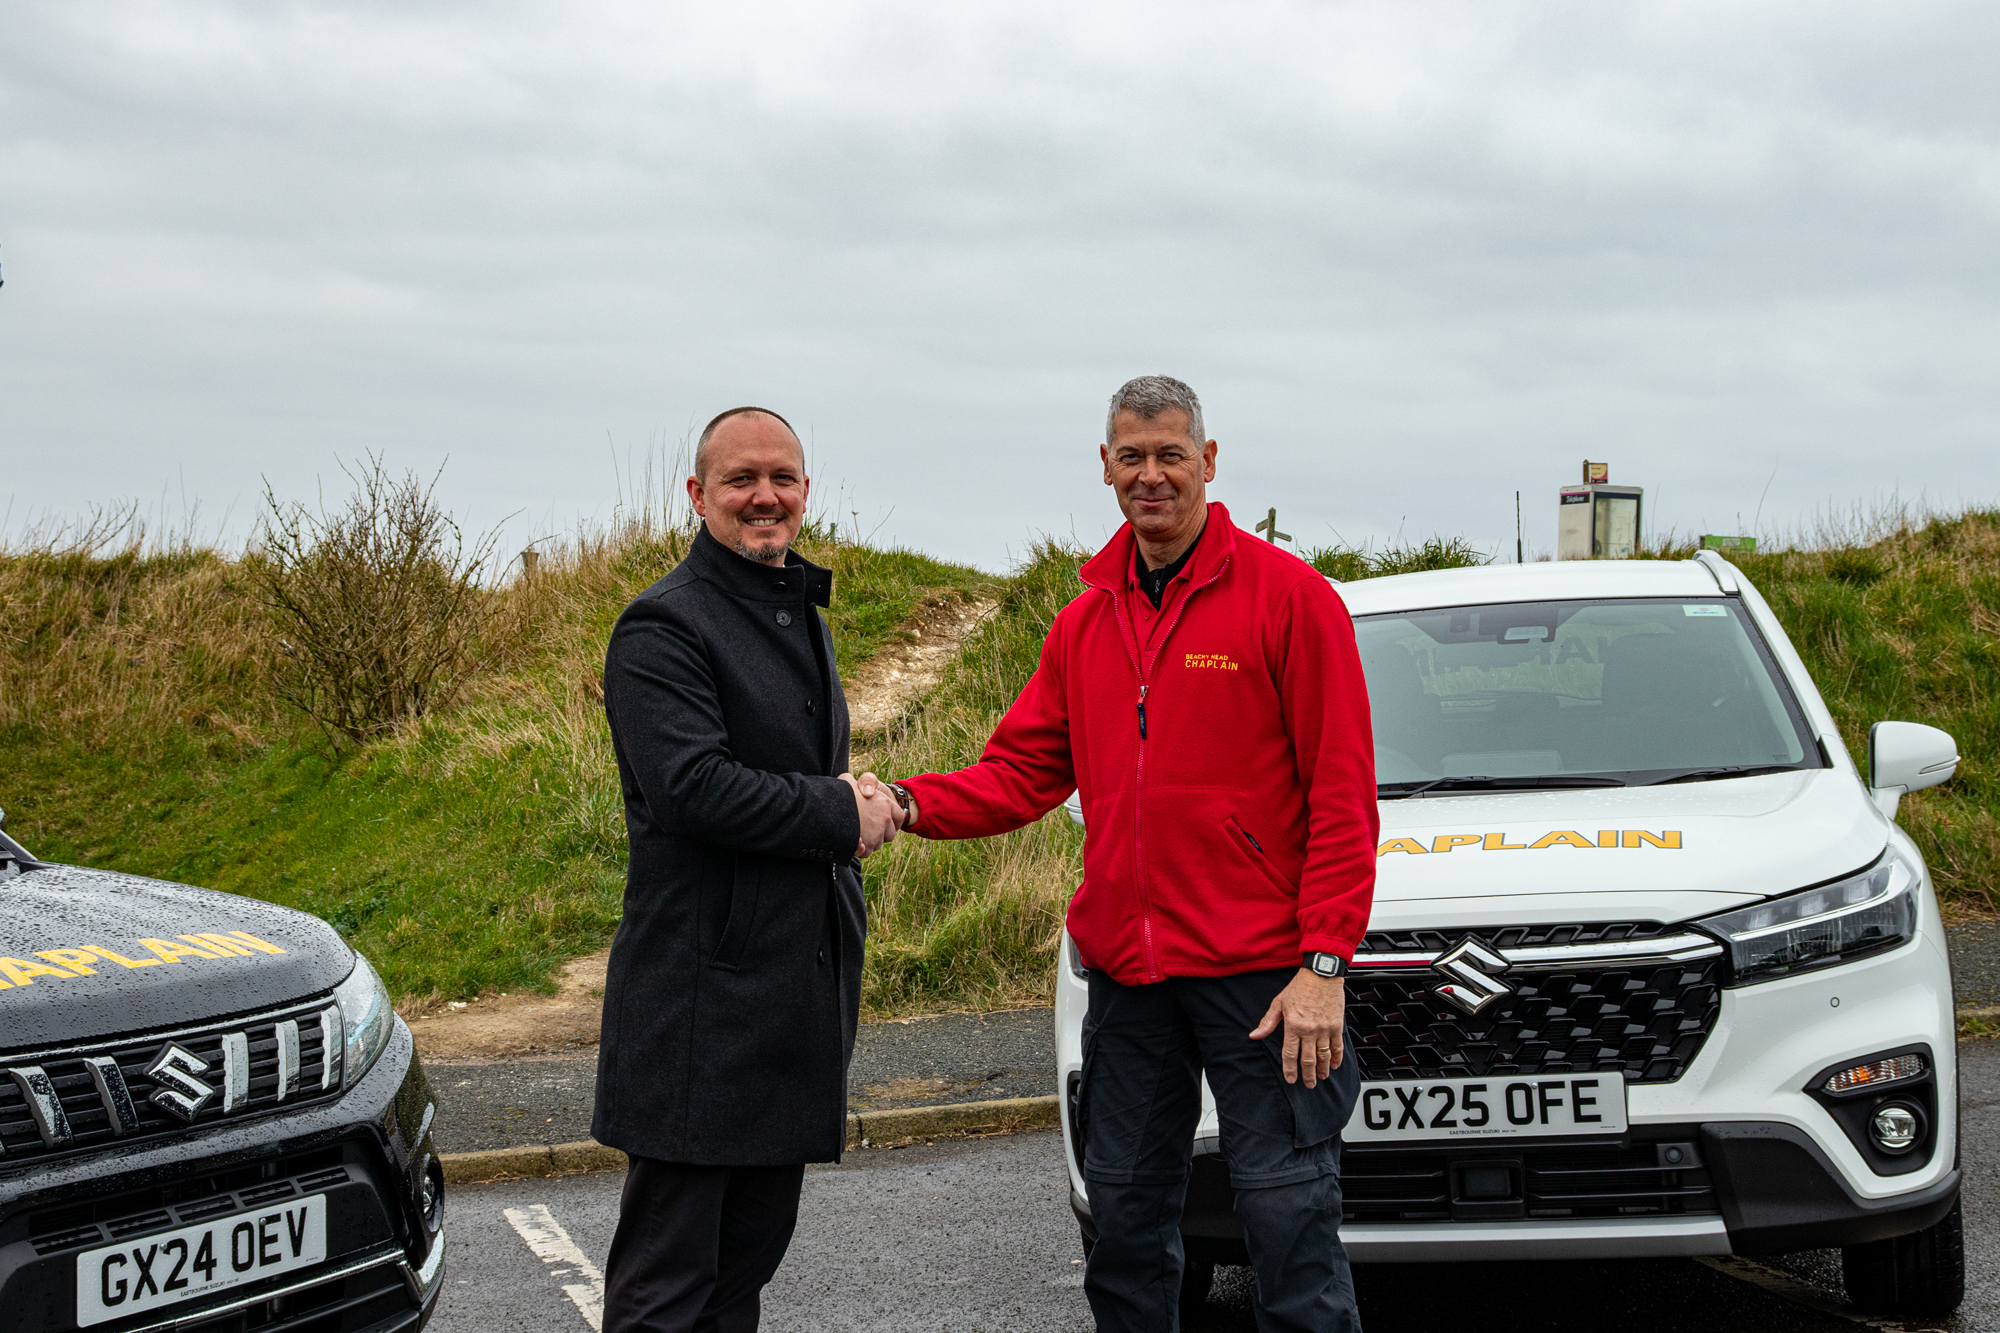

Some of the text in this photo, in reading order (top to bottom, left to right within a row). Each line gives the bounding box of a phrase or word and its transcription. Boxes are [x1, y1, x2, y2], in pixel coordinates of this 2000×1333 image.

[1185, 660, 1239, 671] CHAPLAIN
[0, 930, 287, 990] APLAIN
[1362, 1079, 1602, 1131] GX25 OFE
[101, 1206, 308, 1307] GX24 OEV
[180, 1284, 209, 1297] EASTBOURNE
[209, 1280, 226, 1289] SUZUKI
